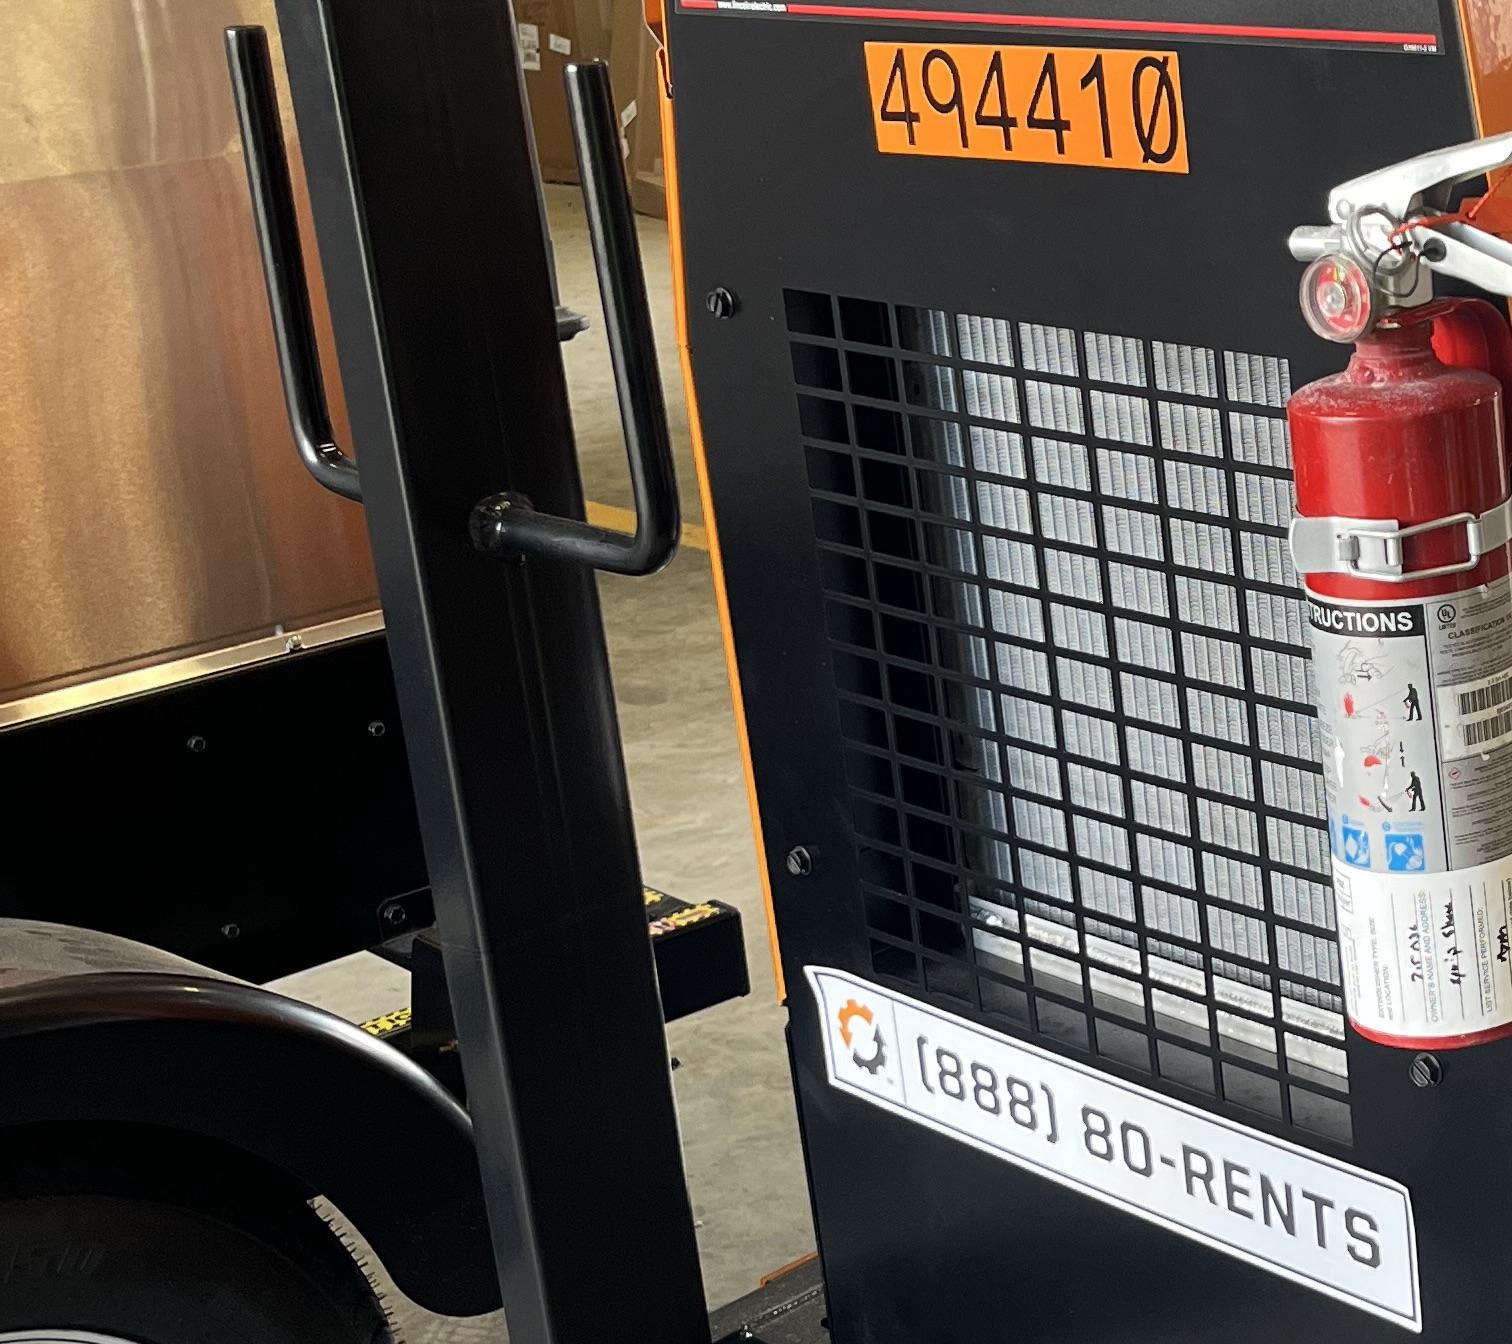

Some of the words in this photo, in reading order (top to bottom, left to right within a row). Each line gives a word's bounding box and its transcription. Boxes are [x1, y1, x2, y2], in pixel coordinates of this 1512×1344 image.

[1422, 936, 1432, 954] AND
[1424, 956, 1434, 981] NAME
[1482, 960, 1491, 994] SERVICE
[914, 1034, 1060, 1144] (888)
[1080, 1105, 1383, 1270] 80-RENTS
